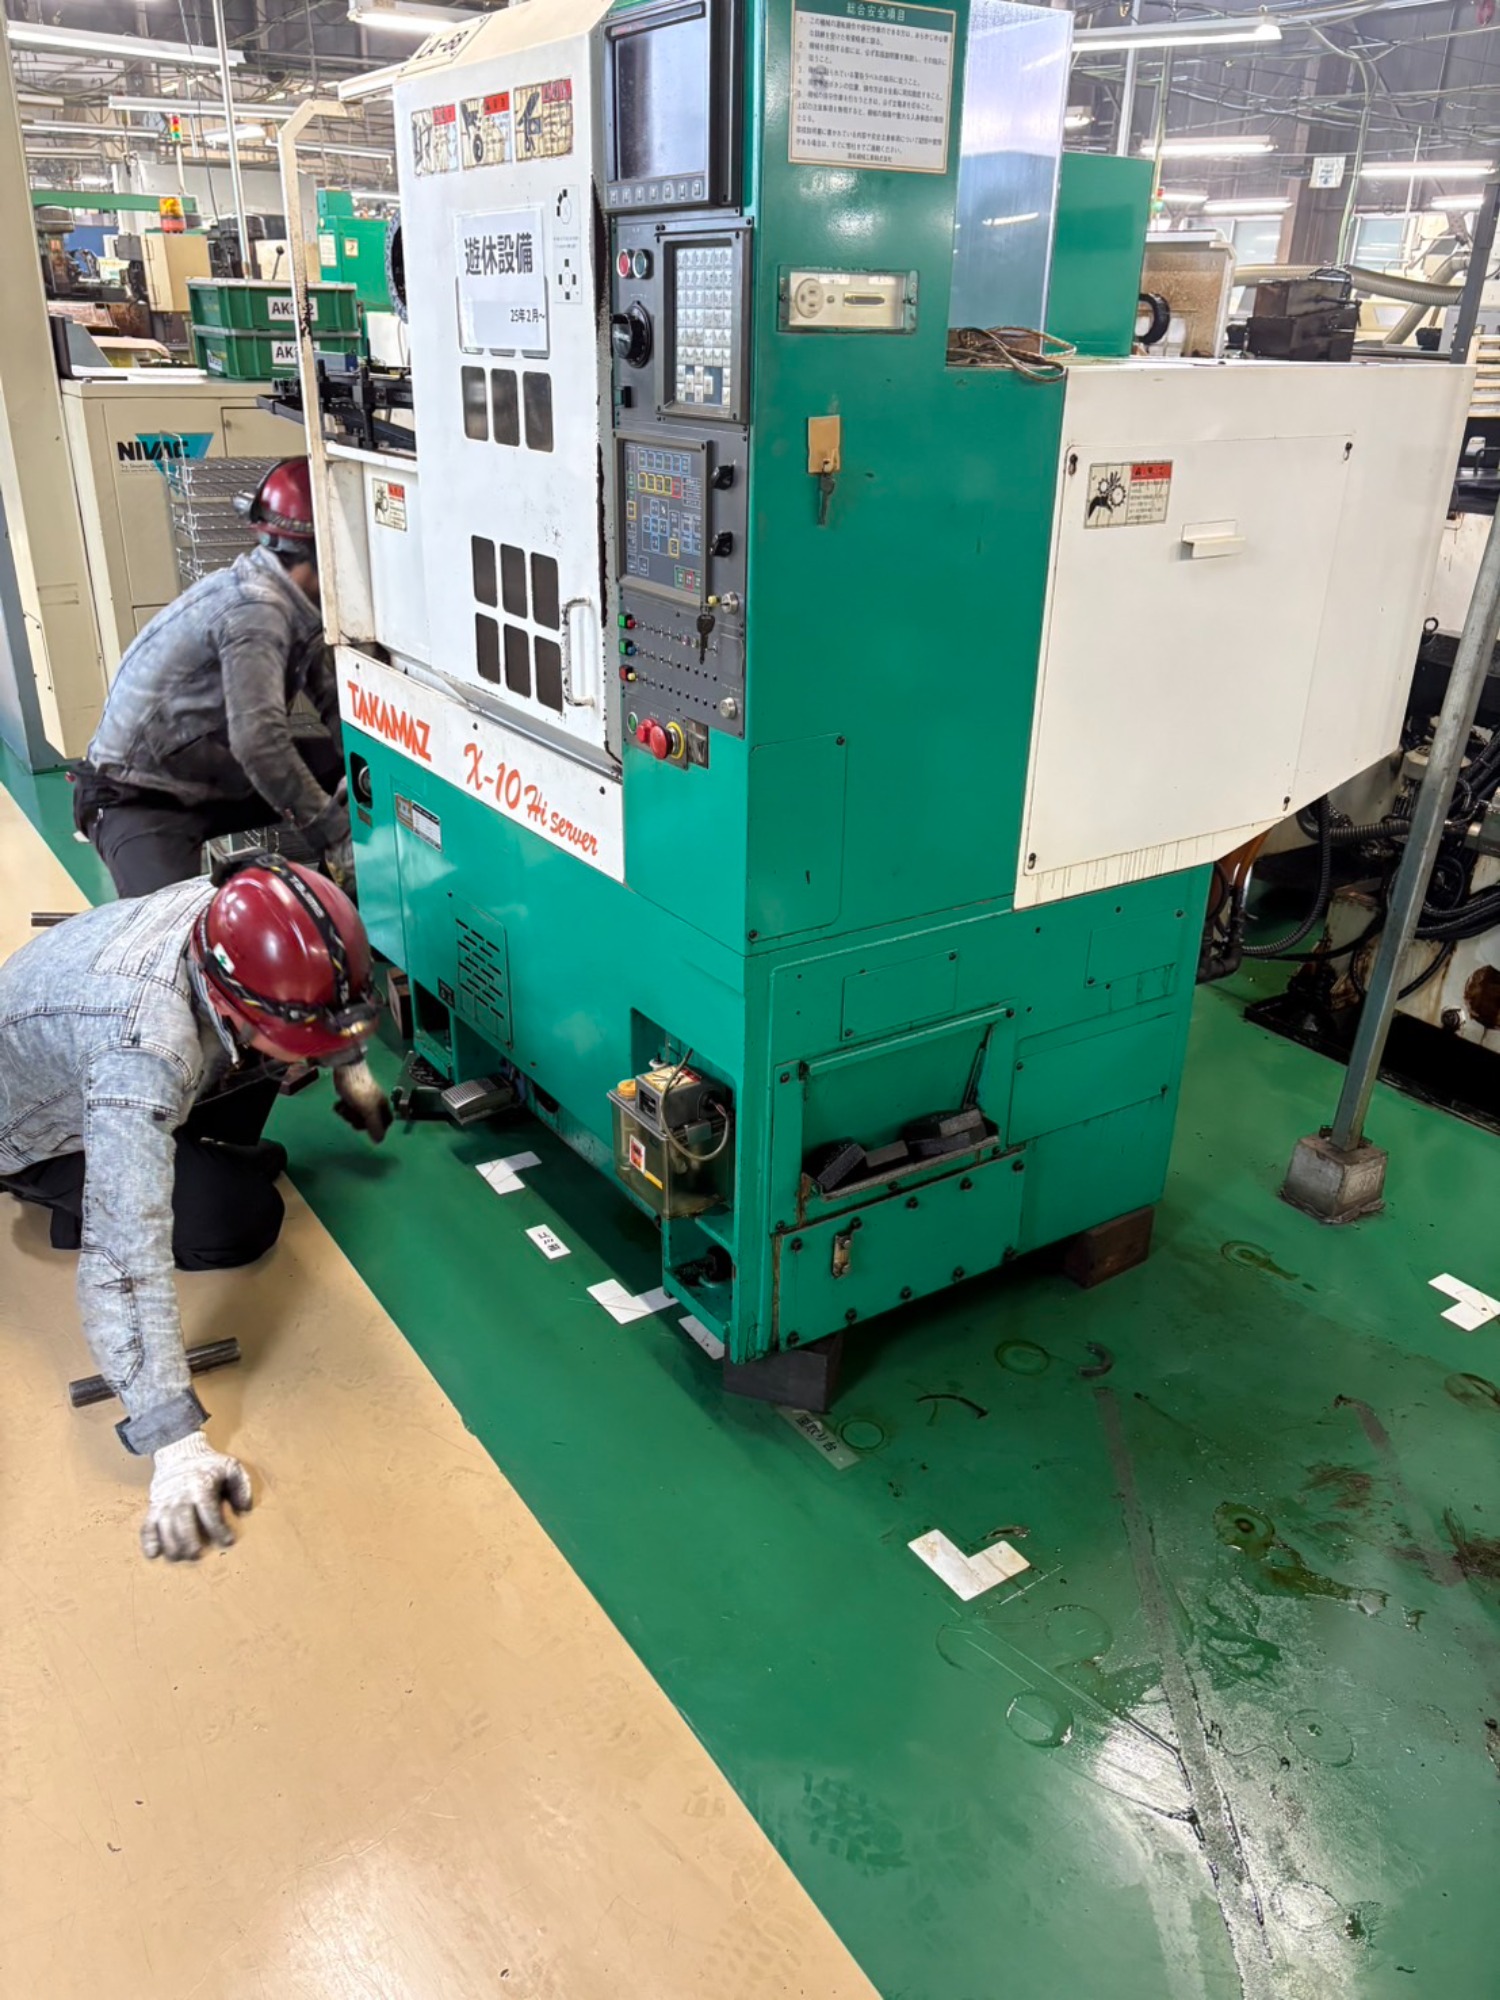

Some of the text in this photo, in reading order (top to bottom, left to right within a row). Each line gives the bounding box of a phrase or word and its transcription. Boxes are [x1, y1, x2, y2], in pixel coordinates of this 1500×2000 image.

[846, 3, 906, 22] 総合安全項目
[464, 232, 533, 276] 遊休設備
[117, 441, 190, 461] NIVAC
[347, 680, 432, 763] TAKAMAZ
[464, 742, 599, 856] X-10 Hi server
